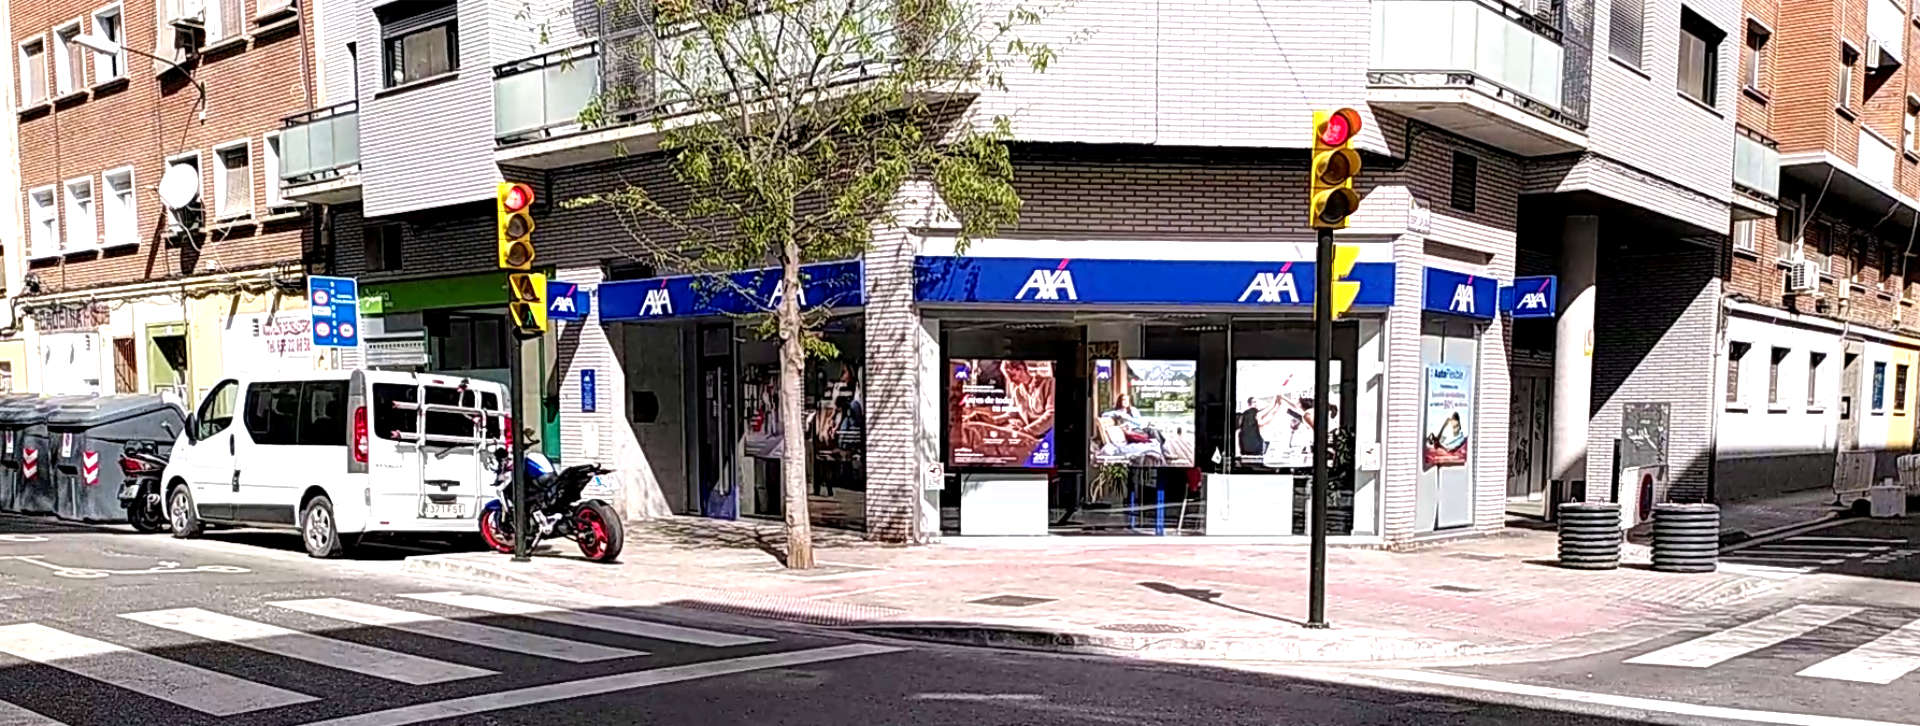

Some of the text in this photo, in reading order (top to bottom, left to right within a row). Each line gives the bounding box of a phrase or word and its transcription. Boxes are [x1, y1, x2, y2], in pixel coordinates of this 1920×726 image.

[1016, 265, 1077, 300] AXA
[1238, 267, 1299, 302] AXA
[1449, 280, 1475, 313] AXA
[1516, 286, 1547, 309] AXA
[550, 291, 576, 312] AXA
[639, 283, 673, 315] AXA
